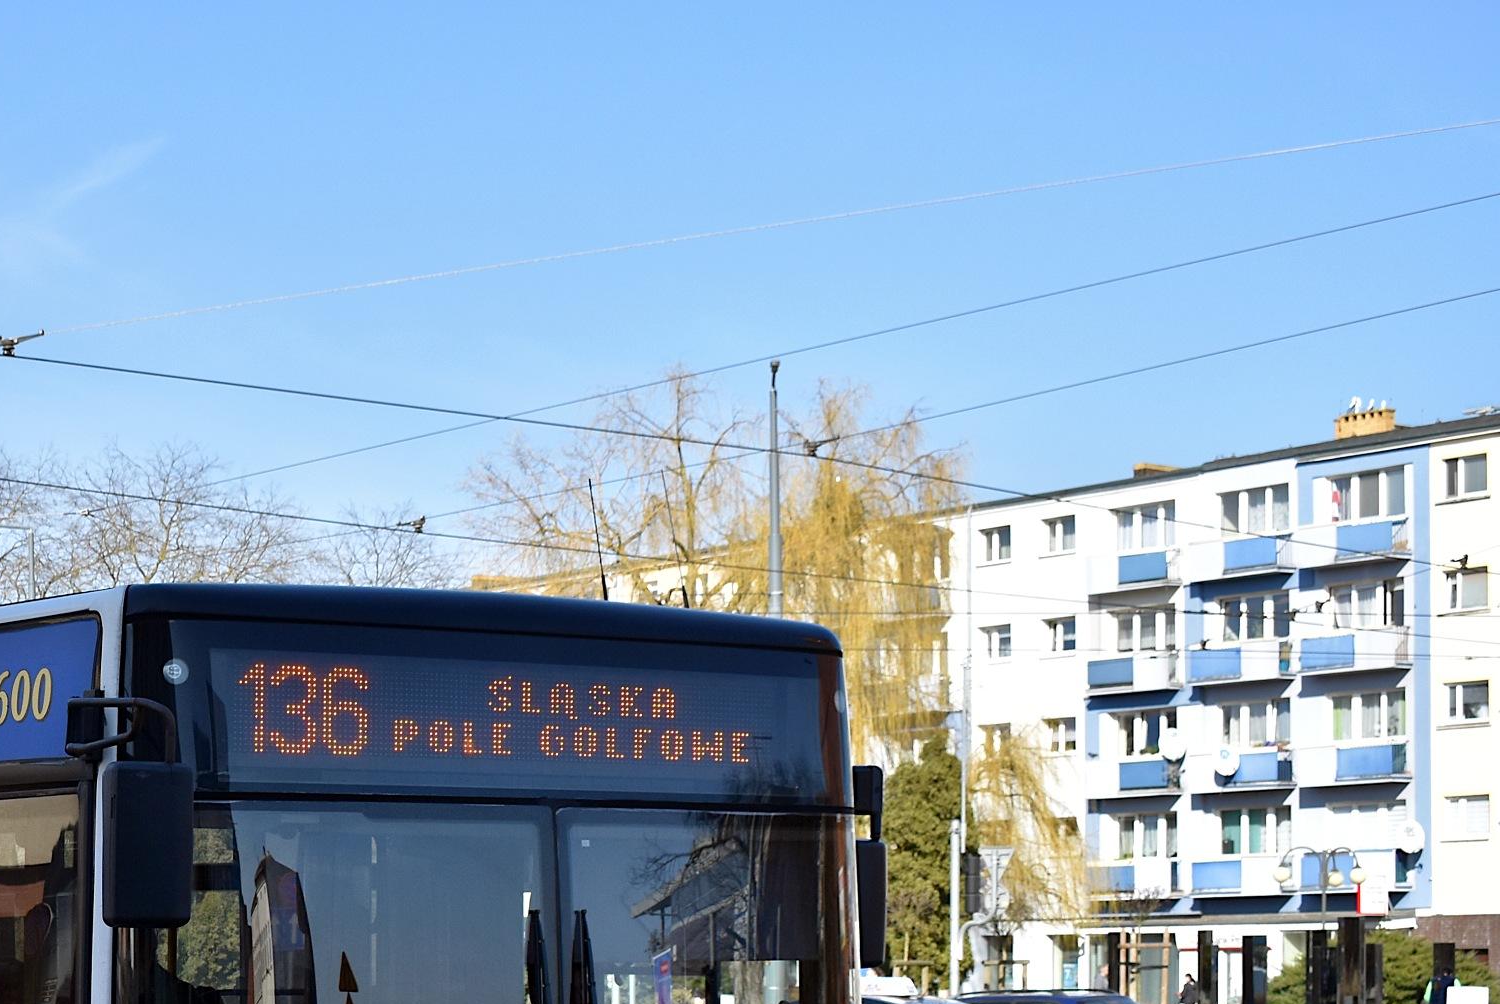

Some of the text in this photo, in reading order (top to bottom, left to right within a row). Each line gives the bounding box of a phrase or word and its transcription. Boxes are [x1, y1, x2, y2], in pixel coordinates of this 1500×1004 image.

[238, 663, 369, 756] 136
[487, 675, 676, 720] ŚLĄSKA
[393, 719, 750, 764] POLE GOLFOWE
